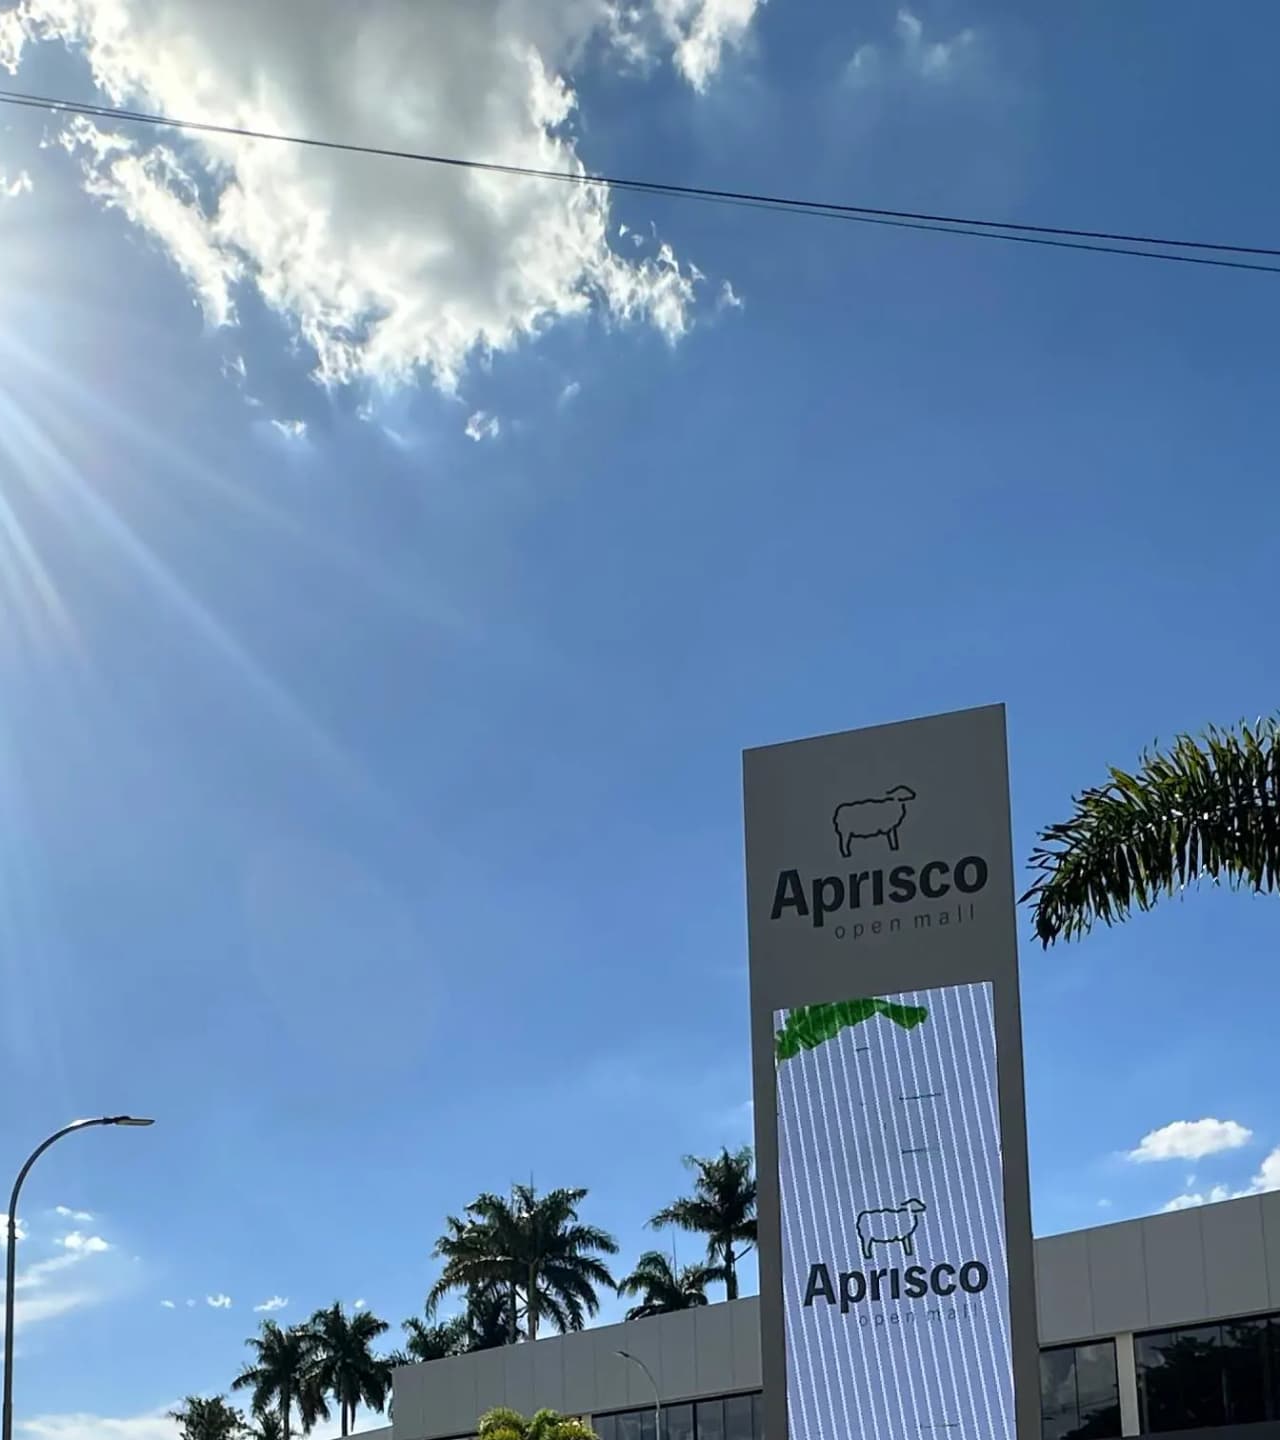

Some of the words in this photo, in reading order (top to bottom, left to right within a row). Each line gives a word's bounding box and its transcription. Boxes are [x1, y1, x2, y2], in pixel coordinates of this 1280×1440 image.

[770, 855, 988, 928] Aprisco
[834, 916, 902, 939] open
[914, 904, 975, 928] mall
[803, 1260, 989, 1314] Aprisco
[858, 1310, 916, 1328] open
